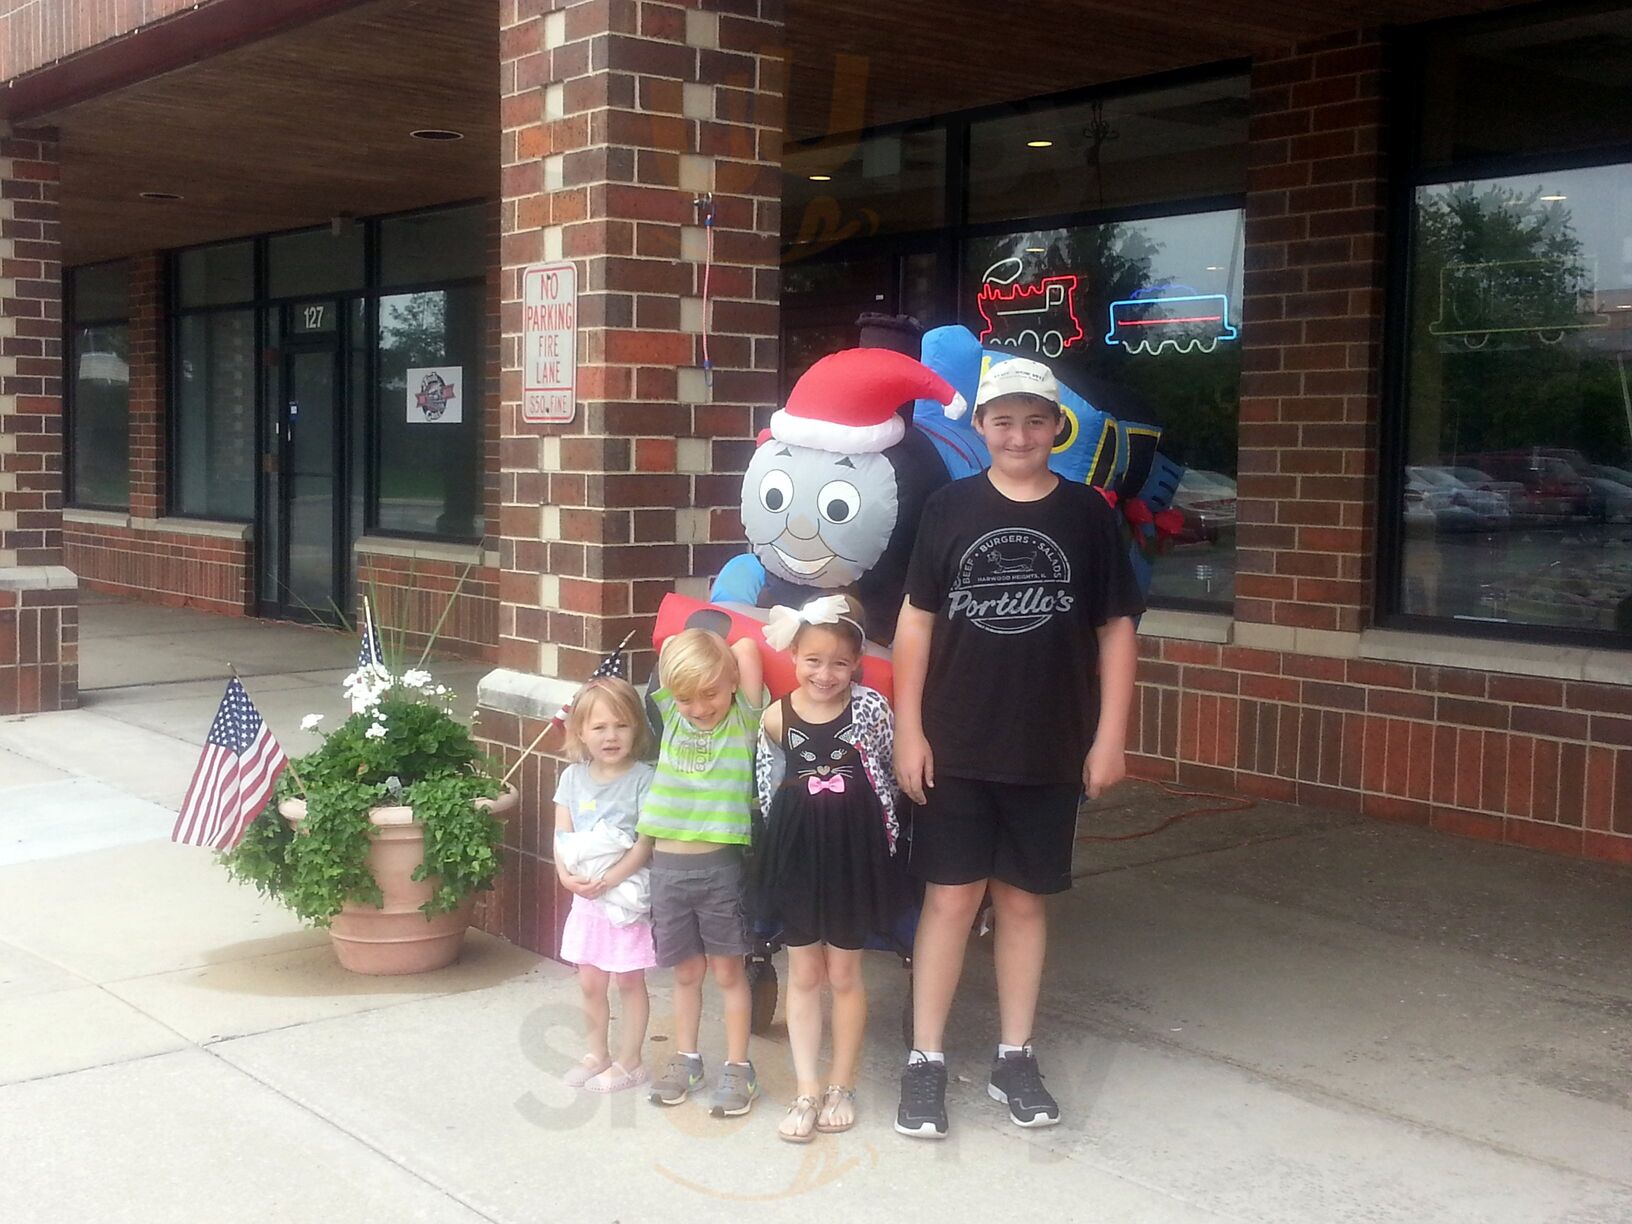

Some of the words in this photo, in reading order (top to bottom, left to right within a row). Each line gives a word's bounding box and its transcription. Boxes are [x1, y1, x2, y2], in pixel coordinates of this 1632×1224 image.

[540, 272, 559, 300] NO
[303, 306, 324, 329] 127
[527, 303, 572, 332] PARKING
[538, 334, 559, 358] FIRE
[536, 361, 561, 384] LANE
[550, 395, 568, 414] FINE
[962, 558, 974, 584] BEEF
[979, 535, 1029, 553] BURGERS
[1037, 542, 1062, 578] SALADS
[948, 587, 1074, 620] Portillo's
